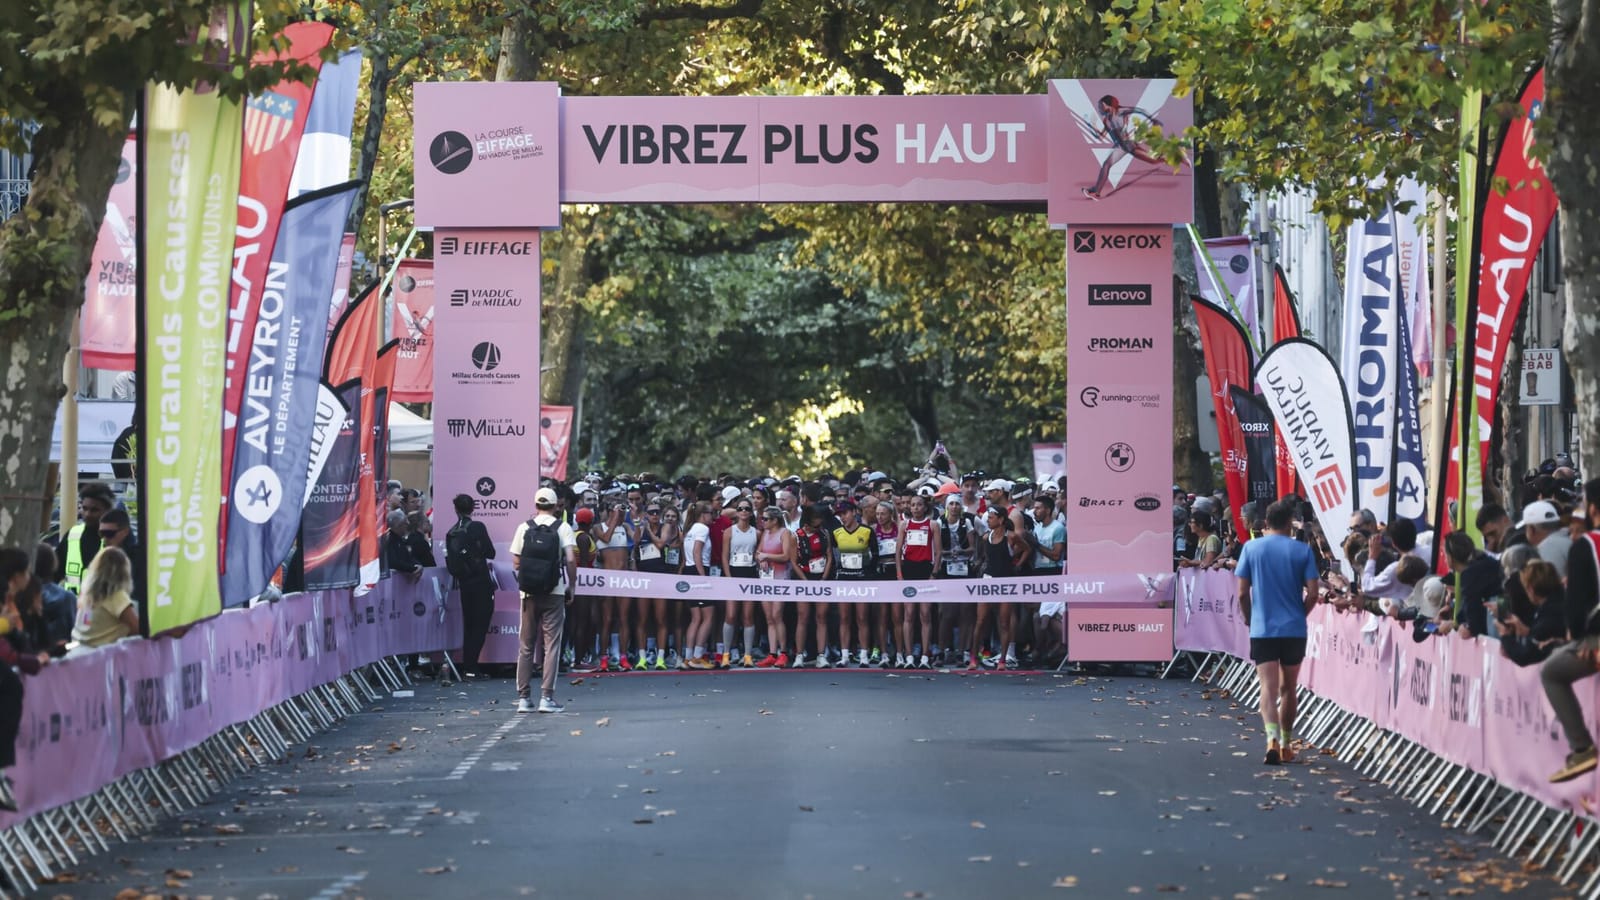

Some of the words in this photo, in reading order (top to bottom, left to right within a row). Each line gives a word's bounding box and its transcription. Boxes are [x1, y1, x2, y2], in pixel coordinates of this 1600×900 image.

[475, 133, 488, 142] LA
[488, 126, 525, 139] COURSE
[476, 134, 535, 154] EIFFAGE
[582, 124, 748, 165] VIBREZ
[764, 123, 880, 165] PLUS
[895, 122, 1026, 164] HAUT
[160, 131, 191, 301] Causses
[464, 241, 532, 255] EIFFAGE
[1101, 234, 1163, 249] xerox
[197, 172, 223, 329] COMMUNES
[472, 289, 513, 298] VIADUC
[1094, 289, 1146, 300] Lenovo
[482, 298, 521, 307] MILLAU
[400, 344, 417, 352] LUS
[1088, 338, 1153, 352] PROMAN
[243, 261, 289, 454] AVEYRON
[1521, 361, 1553, 369] EBAB
[1523, 353, 1552, 361] LLAU
[275, 315, 301, 432] DÉPARTEMENT
[156, 313, 182, 466] Grands
[468, 419, 525, 438] MILLAU
[273, 435, 286, 455] LE
[1411, 434, 1421, 452] LE
[473, 499, 518, 510] EYRON
[156, 478, 184, 607] Millau
[576, 574, 606, 588] LUS
[609, 576, 651, 590] HAUT
[739, 583, 791, 596] VIBREZ
[795, 585, 832, 597] PLUS
[836, 586, 878, 597] HAUT
[966, 583, 1018, 596] VIBREZ
[1022, 582, 1059, 595] PLUS
[1064, 581, 1105, 595] HAUT
[1078, 623, 1110, 633] VIBREZ
[1113, 623, 1136, 632] PLUS
[1138, 623, 1165, 632] HAUT
